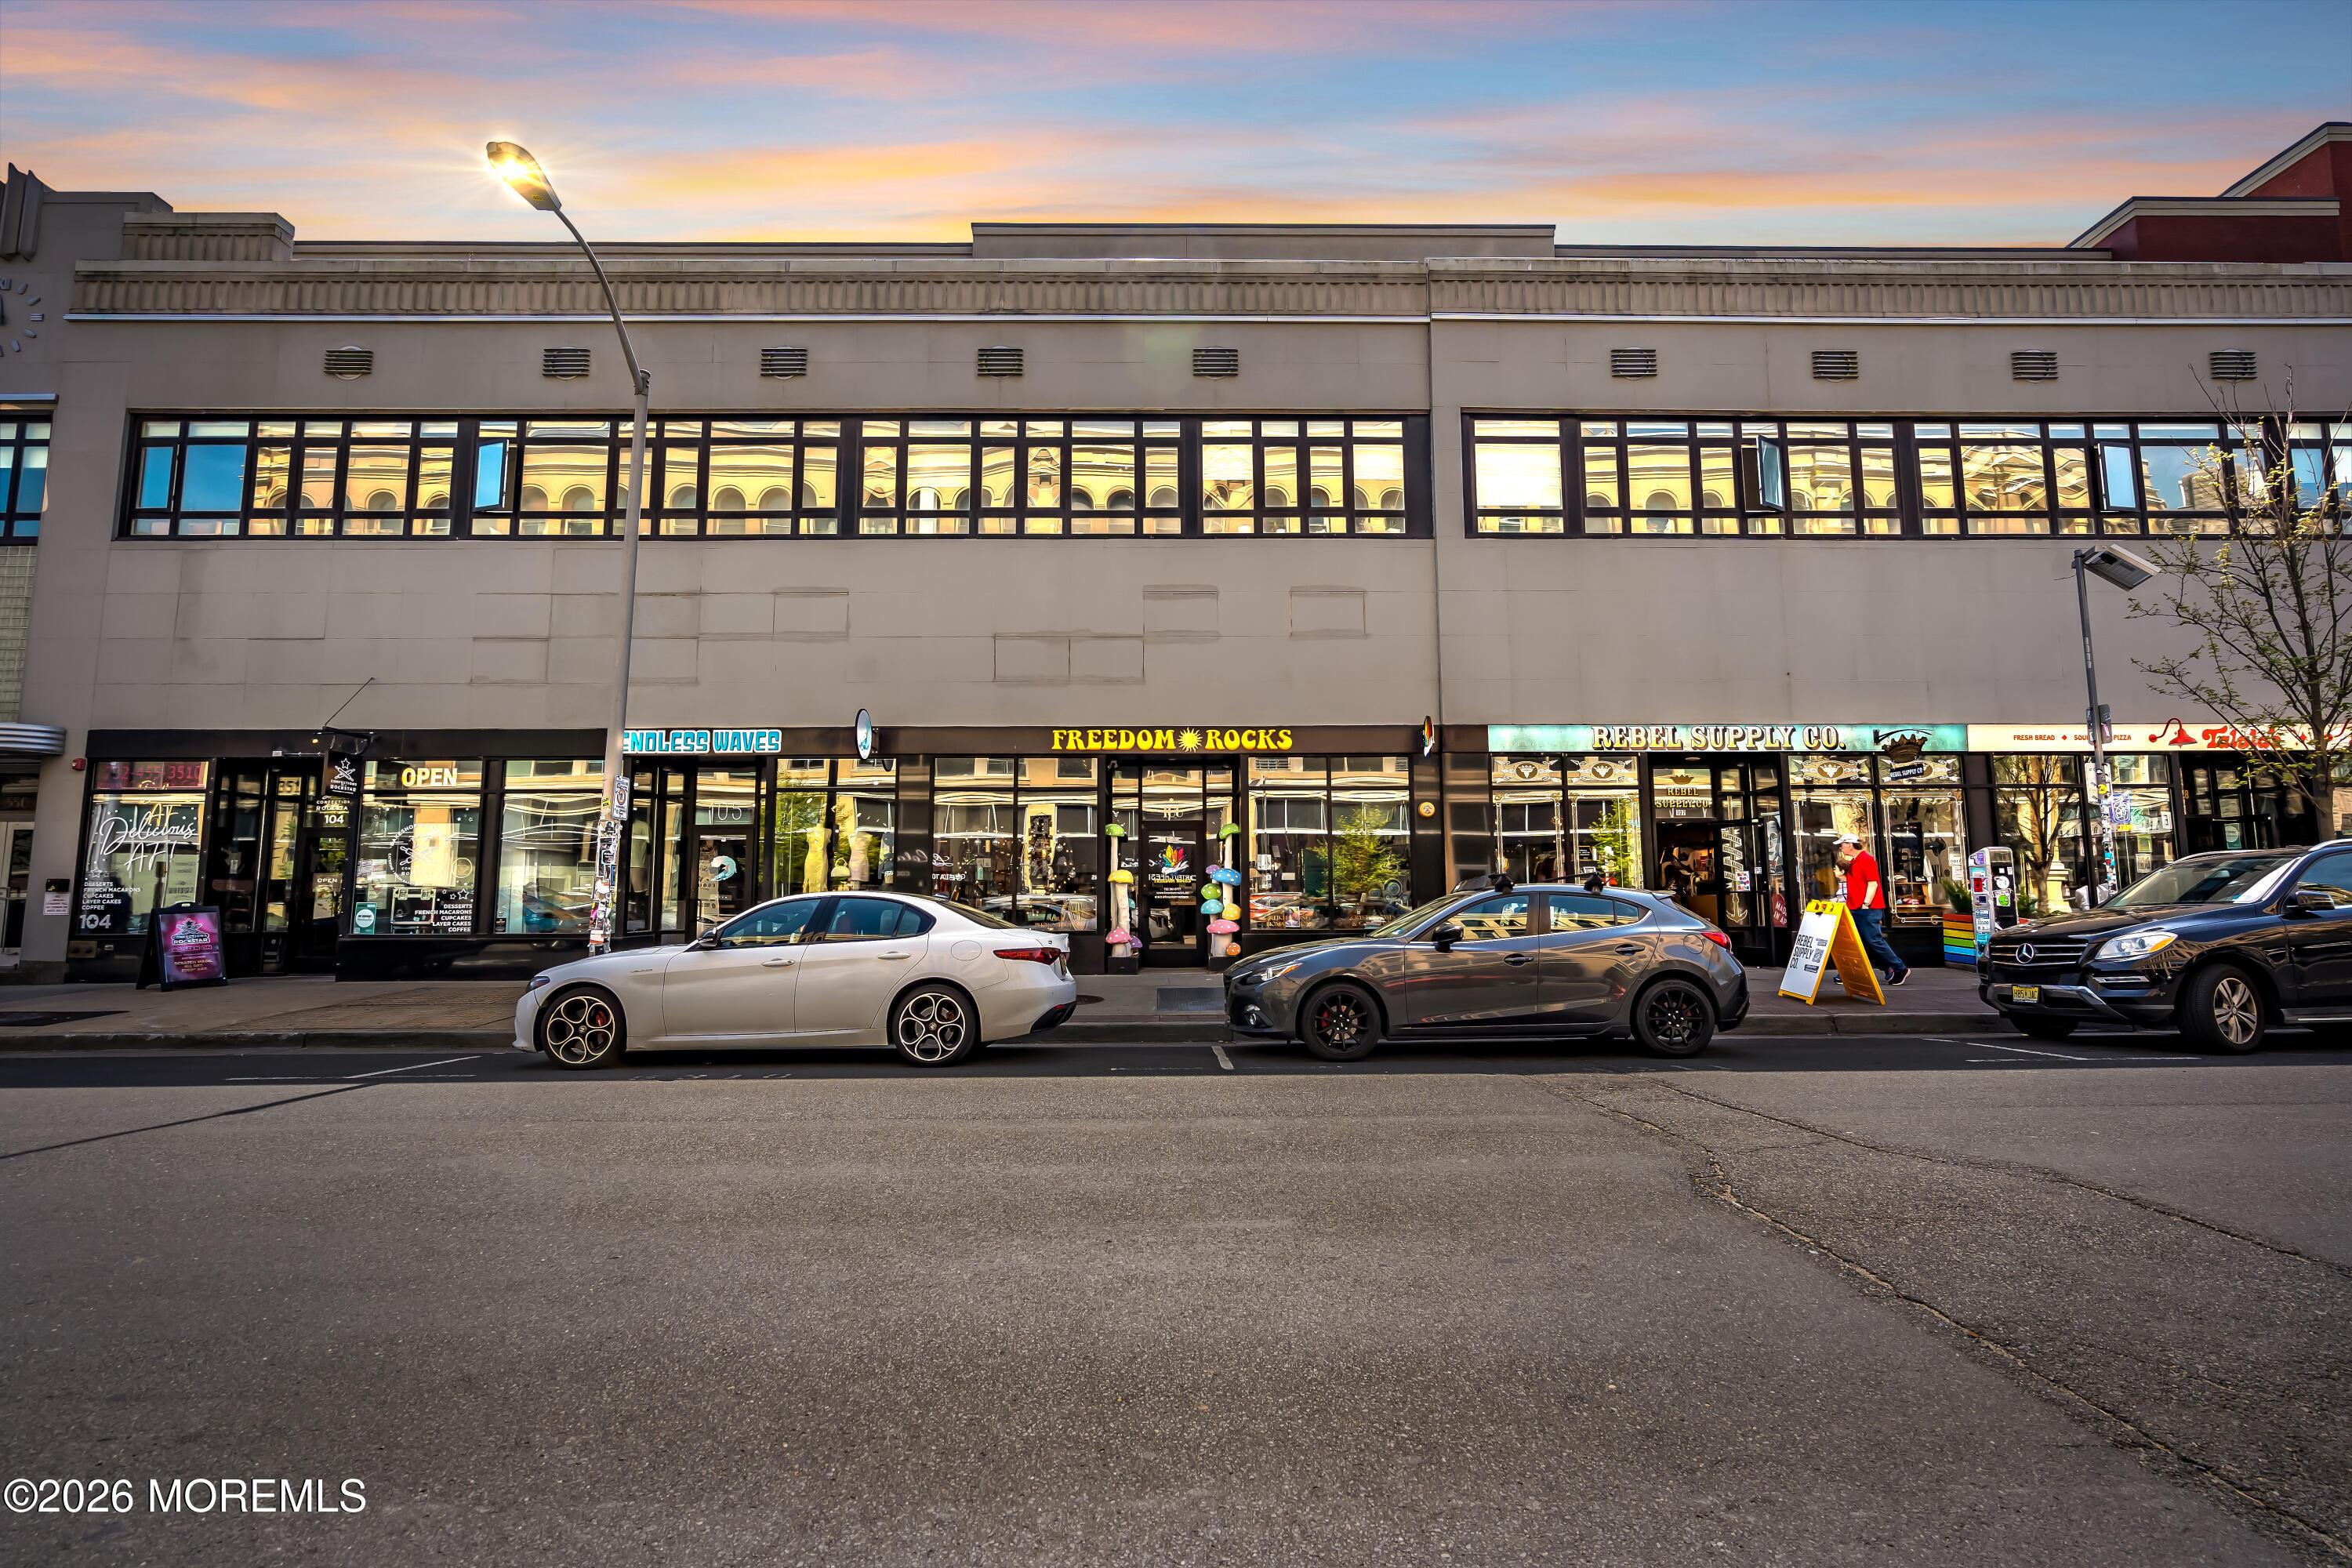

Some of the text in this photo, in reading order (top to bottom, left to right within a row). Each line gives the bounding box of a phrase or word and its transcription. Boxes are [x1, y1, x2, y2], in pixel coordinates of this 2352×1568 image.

[623, 729, 782, 753] ENDLESS WAVES
[1051, 729, 1293, 750] FREEDOM ROCKS
[1592, 725, 1847, 750] REBEL SUPPLY CO.
[401, 768, 458, 787] OPEN
[1667, 787, 1699, 797] REBEL
[1655, 799, 1693, 809] SUPPLY
[325, 815, 344, 824] 104
[99, 816, 196, 856] Delicious
[79, 914, 111, 929] 104
[1796, 934, 1813, 949] REBEL
[1793, 946, 1814, 960] SUPPLY
[1790, 957, 1798, 969] CO.
